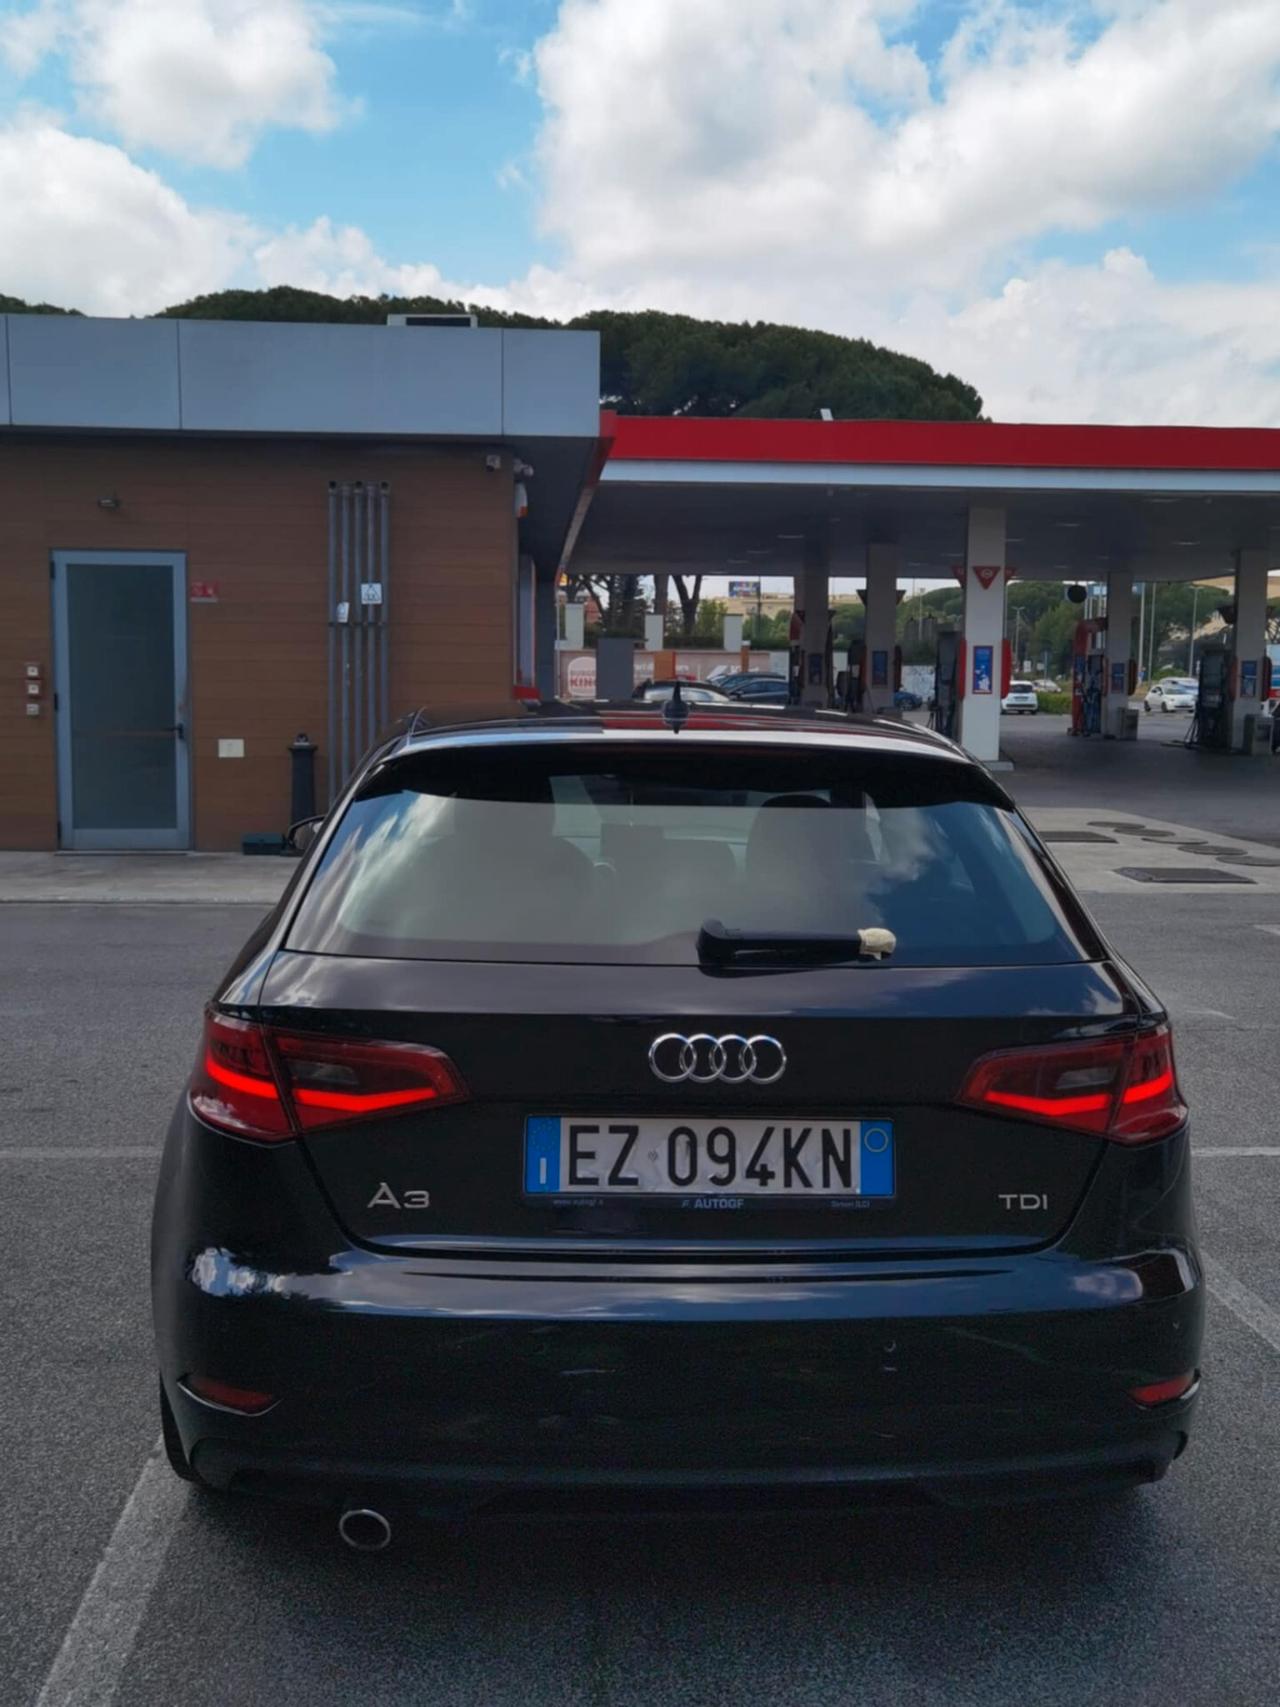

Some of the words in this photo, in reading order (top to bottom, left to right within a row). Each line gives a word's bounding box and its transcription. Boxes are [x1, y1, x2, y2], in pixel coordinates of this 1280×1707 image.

[570, 677, 595, 687] KIN
[568, 1125, 639, 1187] EZ
[667, 1126, 852, 1188] 094KN
[367, 1182, 430, 1209] A3
[998, 1194, 1048, 1210] TDI
